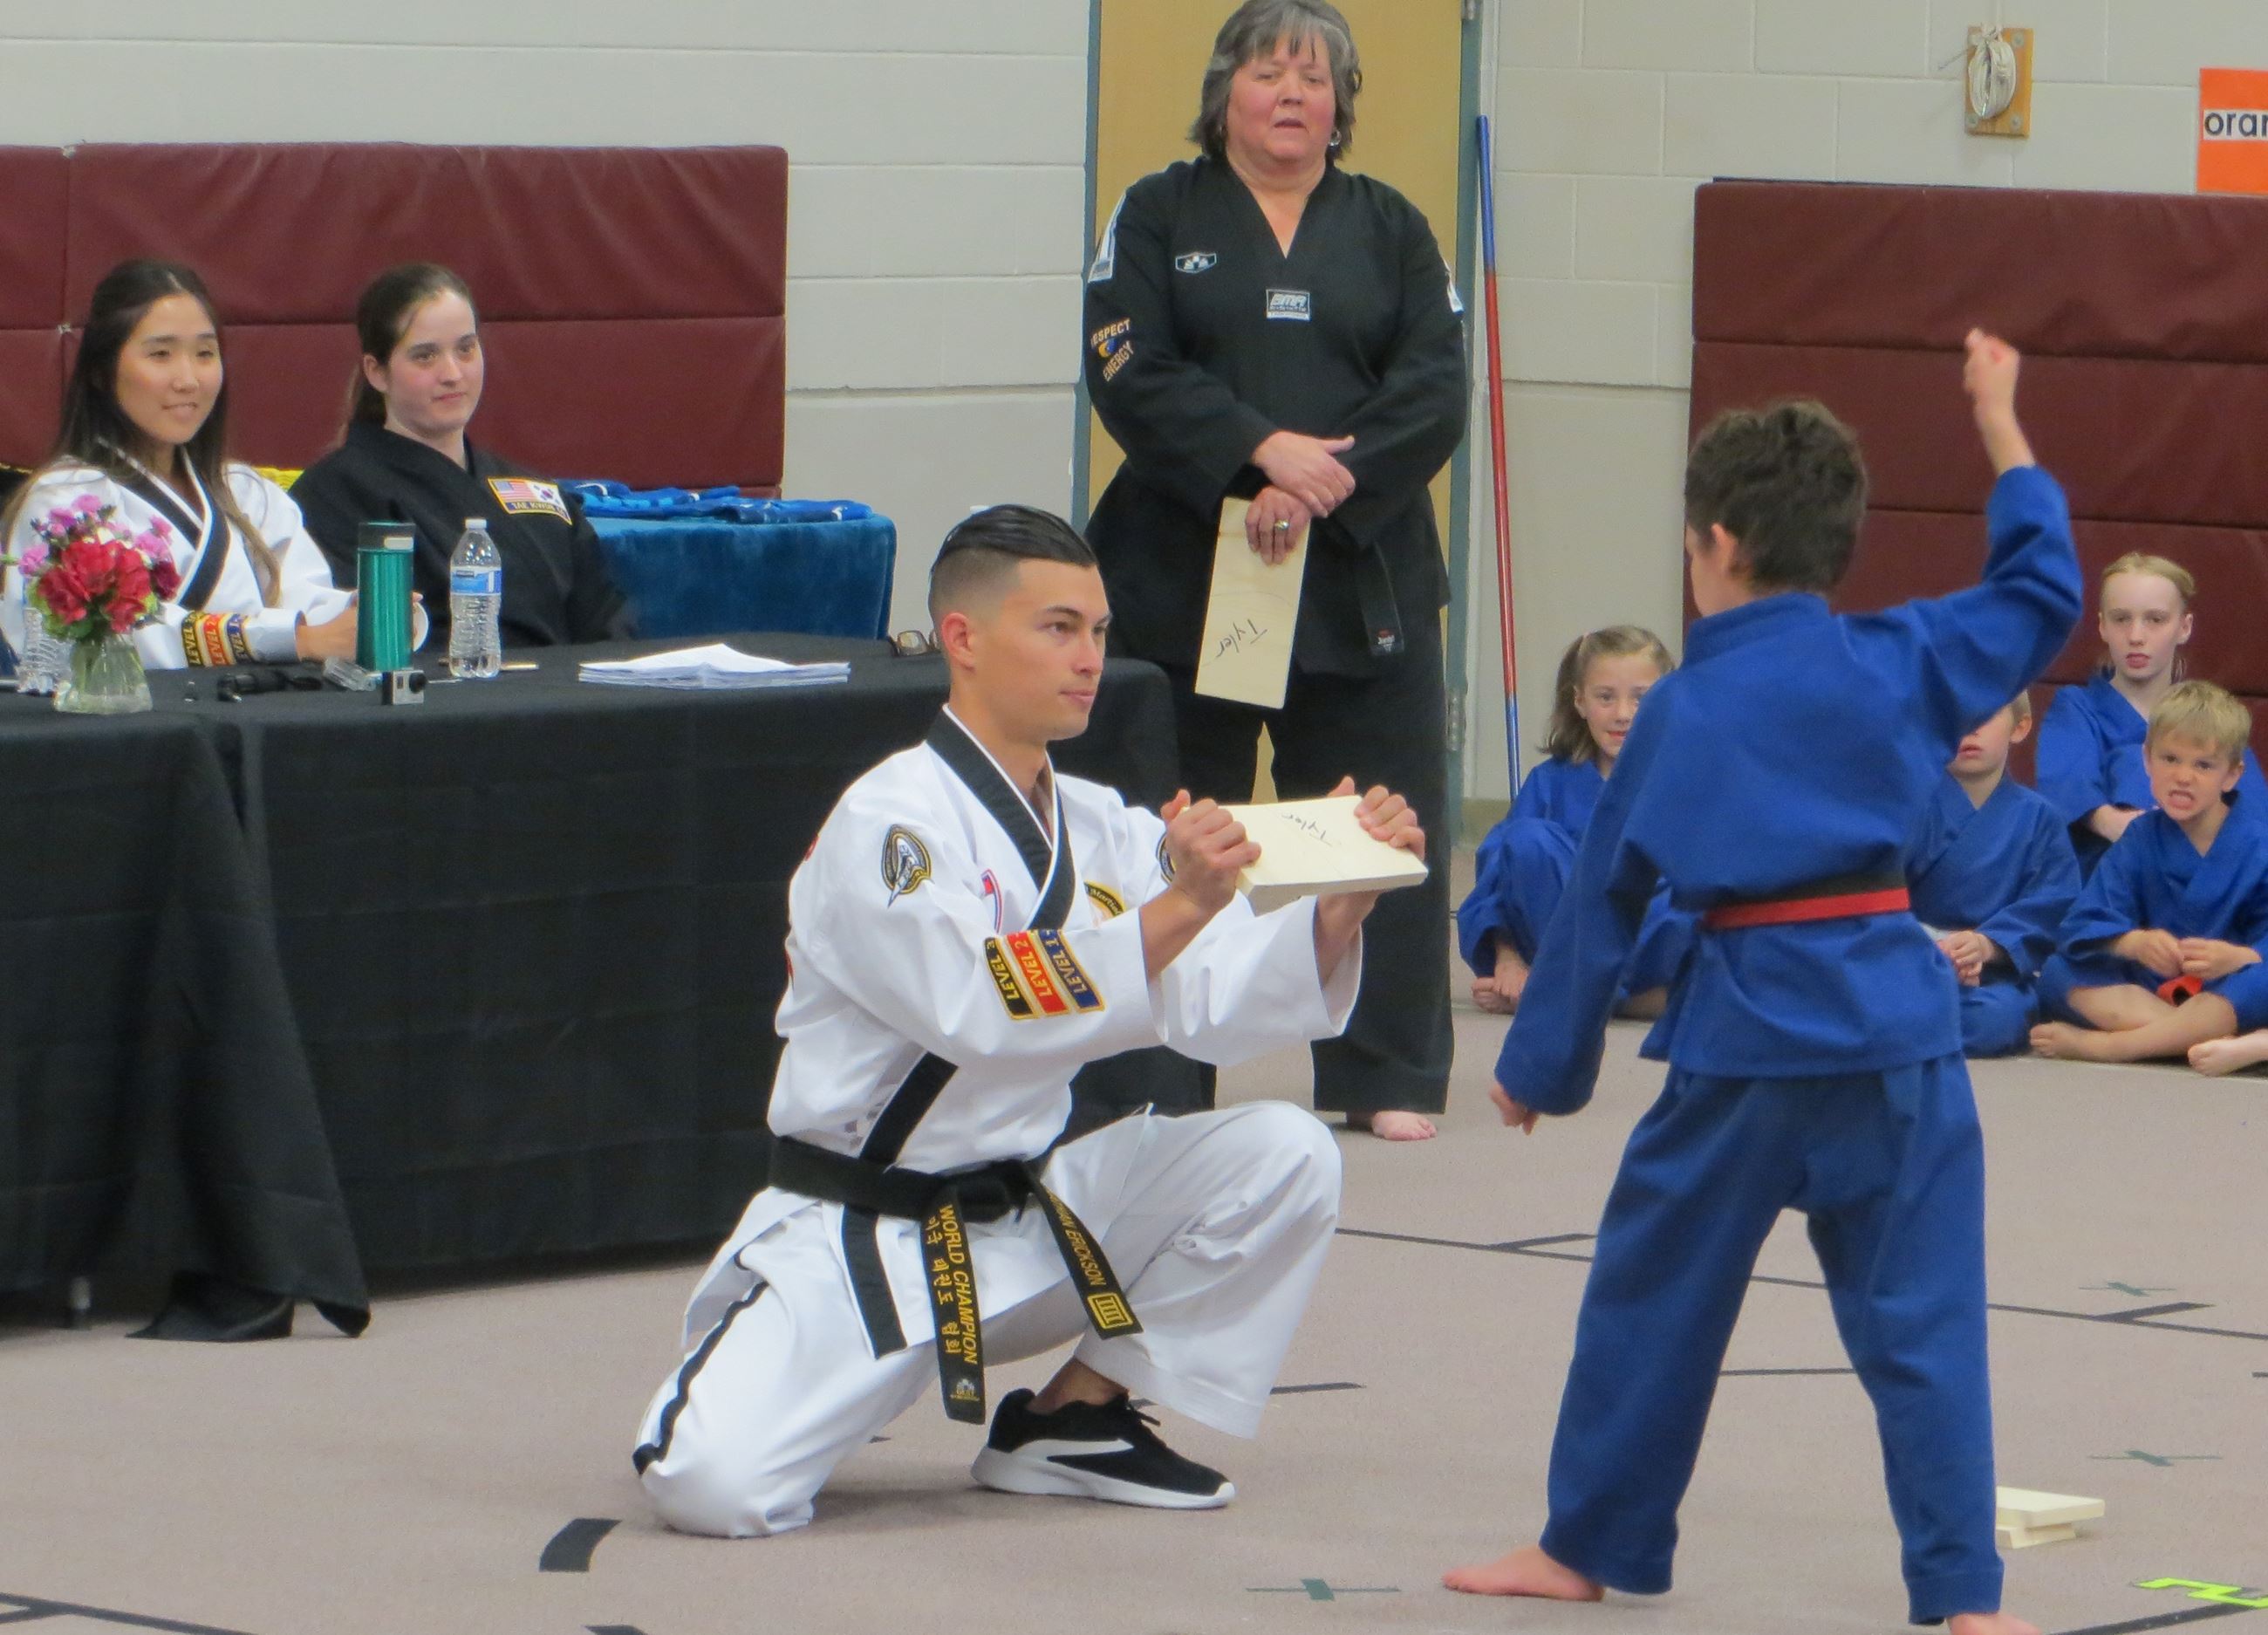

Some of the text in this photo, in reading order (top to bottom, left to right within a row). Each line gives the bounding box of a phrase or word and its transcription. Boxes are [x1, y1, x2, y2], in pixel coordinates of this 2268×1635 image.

[1103, 341, 1134, 381] ENERGY
[1213, 619, 1267, 660] Tyler
[1281, 814, 1333, 847] Tyler
[990, 955, 1020, 1000] LEVEL
[1021, 951, 1053, 996] LEVEL
[1053, 950, 1088, 994] LEVEL
[1065, 1228, 1106, 1285] ERICKSON
[939, 1204, 965, 1263] WORLD
[953, 1270, 978, 1365] CHAMPION
